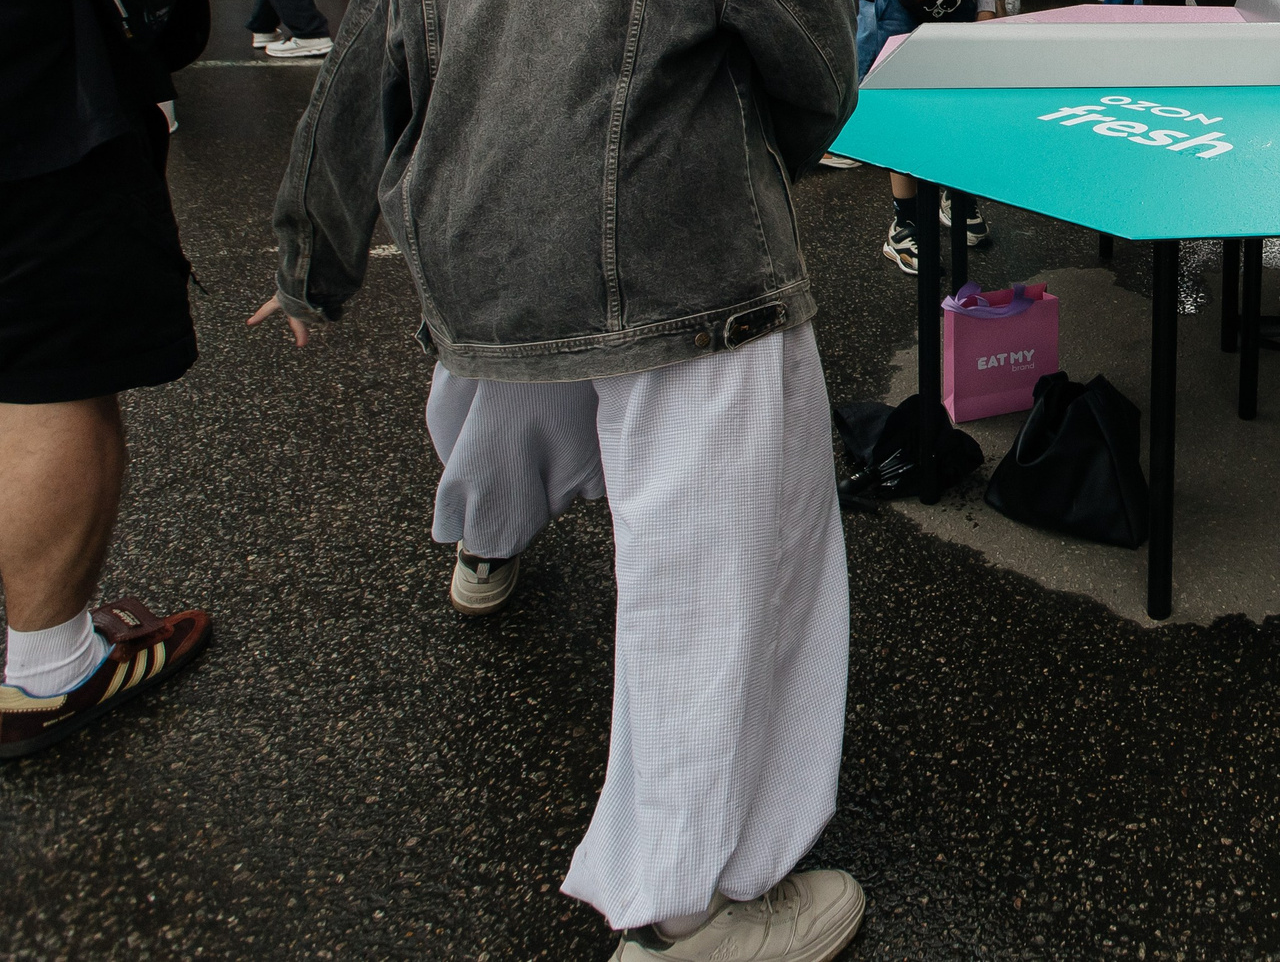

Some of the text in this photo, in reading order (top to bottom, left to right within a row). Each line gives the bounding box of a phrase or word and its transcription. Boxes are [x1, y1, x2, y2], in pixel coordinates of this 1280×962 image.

[1036, 105, 1234, 159] fresh
[977, 349, 1035, 371] EAT MY
[1011, 361, 1035, 372] brand
